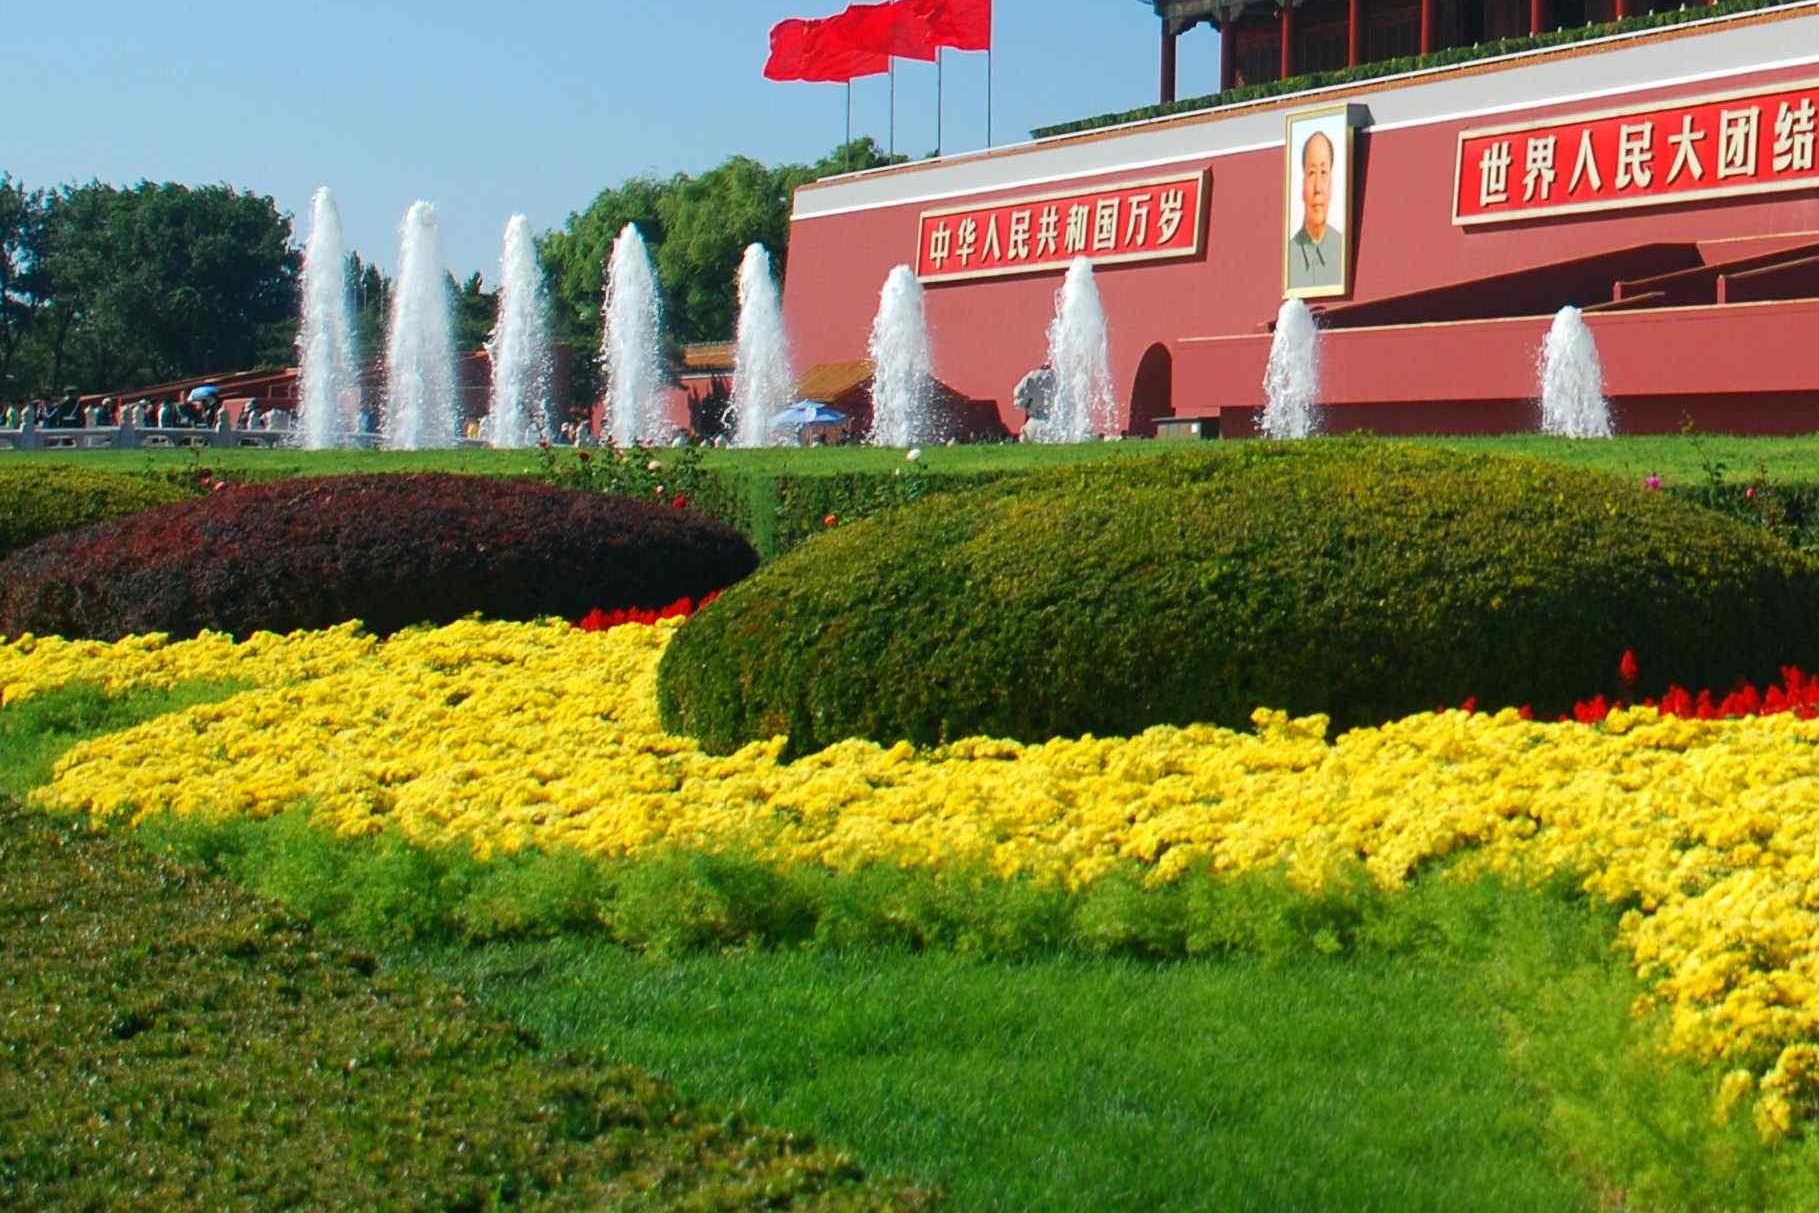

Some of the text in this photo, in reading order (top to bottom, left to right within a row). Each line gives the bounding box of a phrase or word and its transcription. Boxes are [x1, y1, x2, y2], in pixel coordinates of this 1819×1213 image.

[929, 188, 1185, 269] 中华人民共和国万岁
